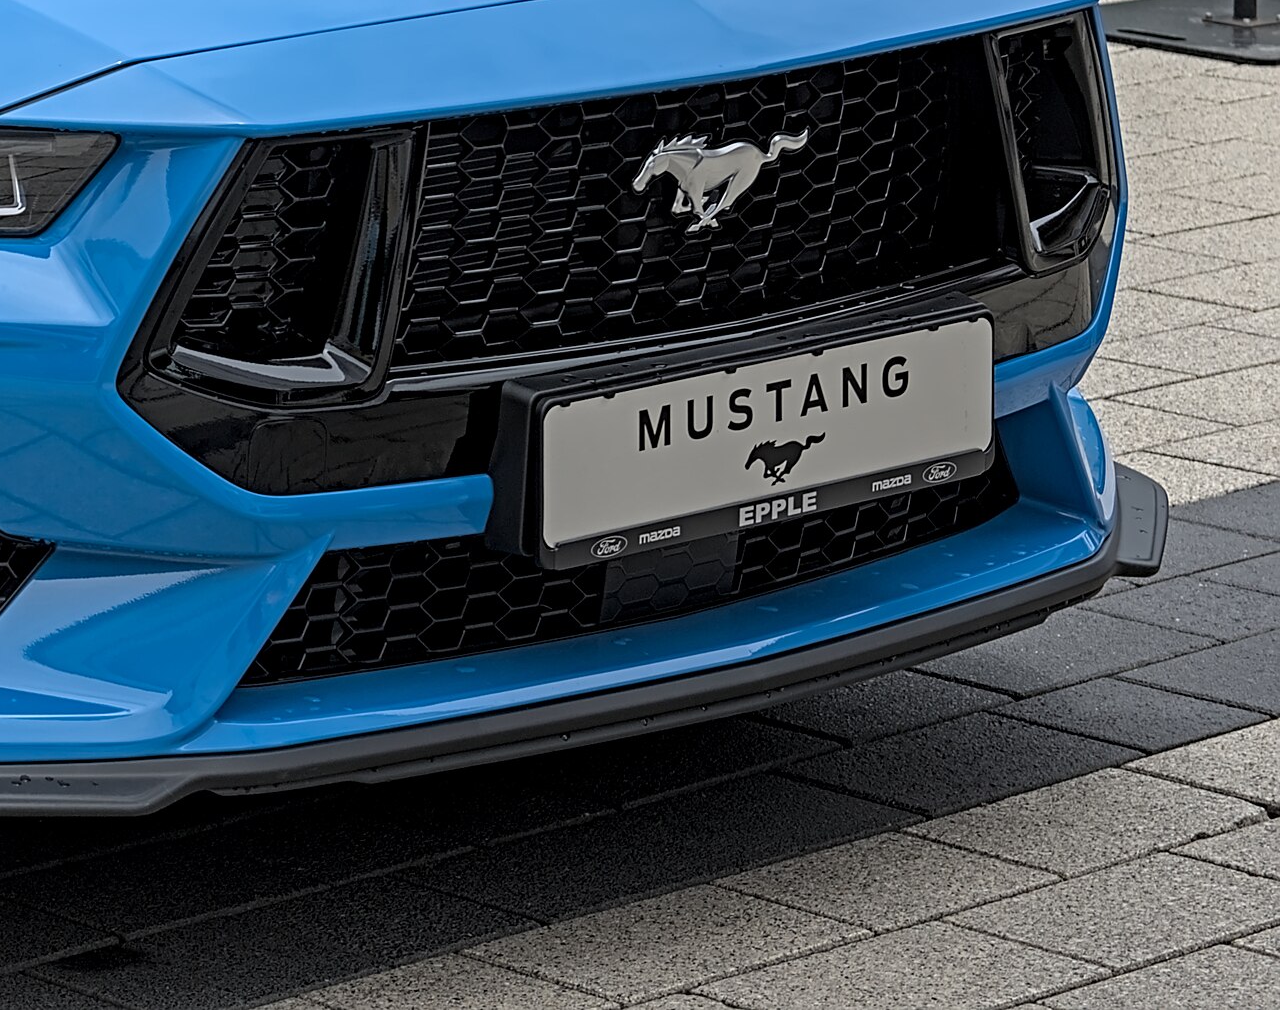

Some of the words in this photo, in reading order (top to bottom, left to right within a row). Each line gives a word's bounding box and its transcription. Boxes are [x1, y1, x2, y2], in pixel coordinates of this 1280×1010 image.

[638, 355, 910, 452] MUSTANG
[595, 540, 622, 554] Ford
[639, 526, 681, 545] mazda
[739, 491, 817, 527] EPPLE
[872, 474, 911, 492] mazda
[926, 464, 951, 480] Ford
